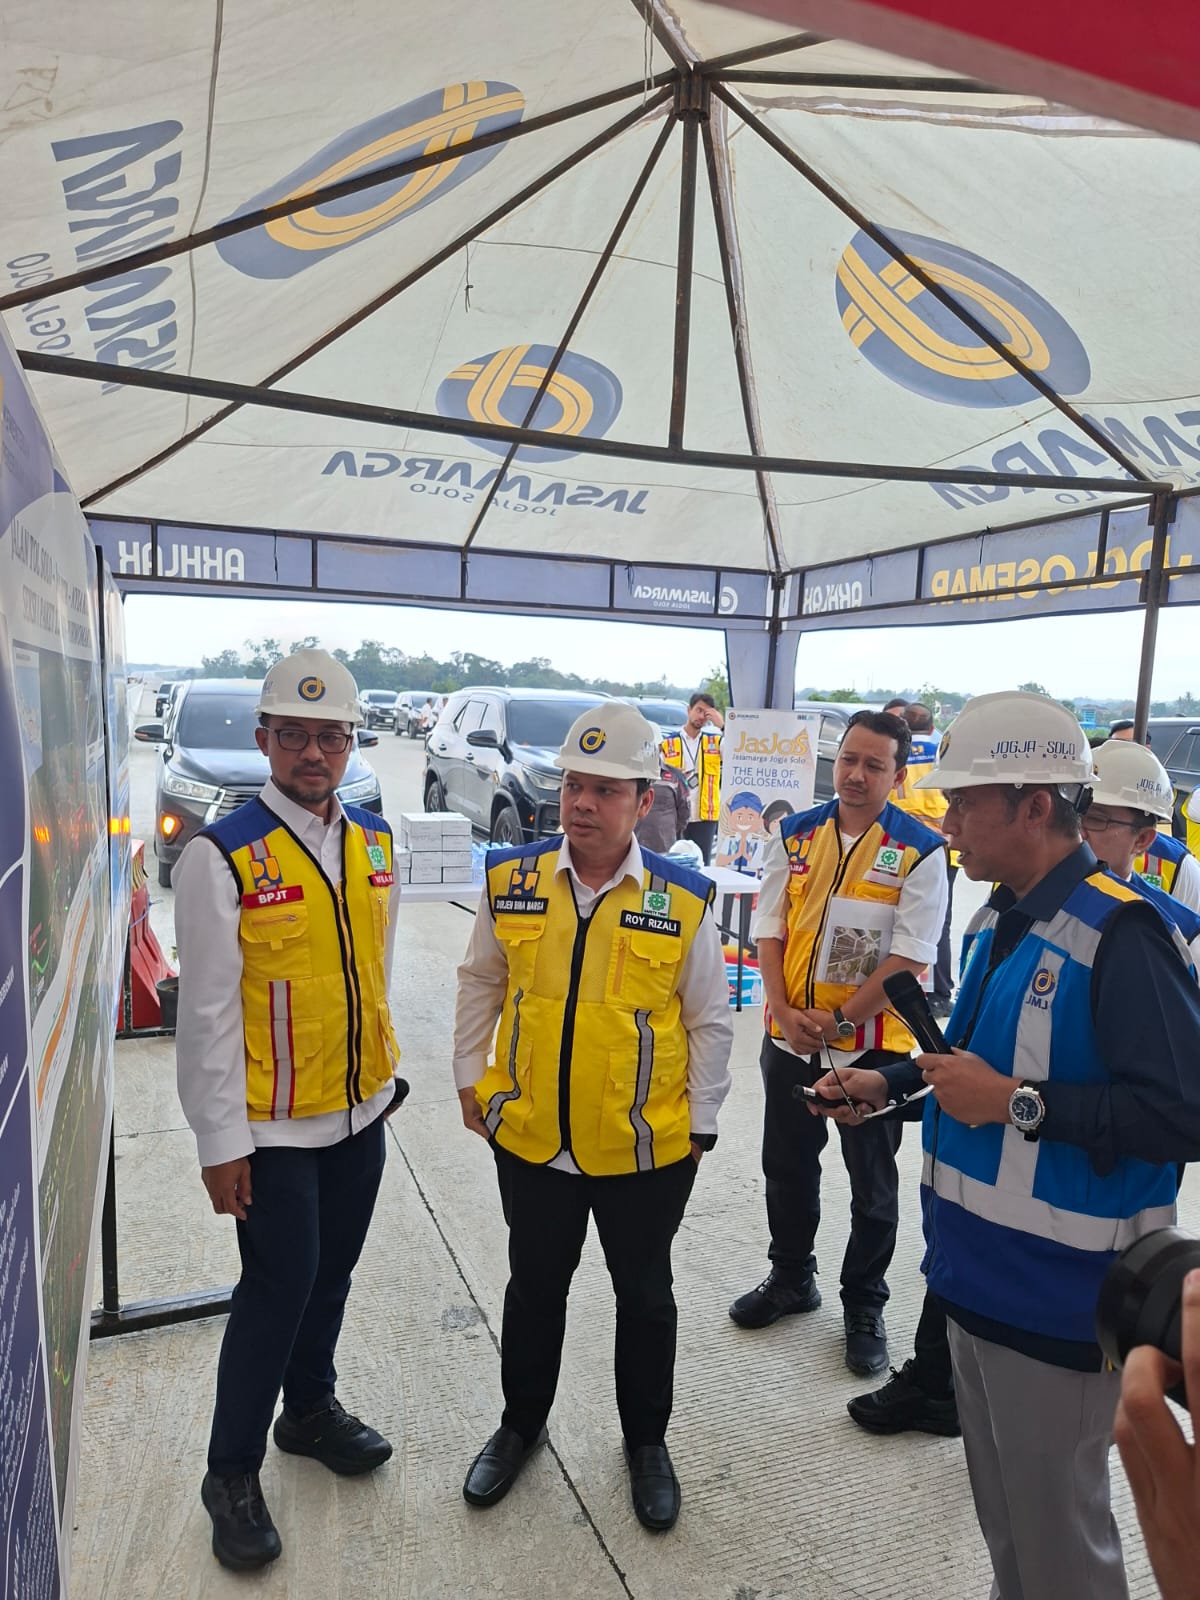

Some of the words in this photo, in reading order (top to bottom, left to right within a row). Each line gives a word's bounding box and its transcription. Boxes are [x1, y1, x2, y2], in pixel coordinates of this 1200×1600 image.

[733, 766, 753, 776] THE
[756, 767, 778, 778] HUB
[781, 769, 796, 778] OF
[730, 776, 800, 788] JOGLOSEMAR
[258, 889, 288, 904] BPJT
[625, 913, 645, 926] ROY
[648, 918, 677, 932] RIZALI
[1025, 994, 1048, 1010] JMJ
